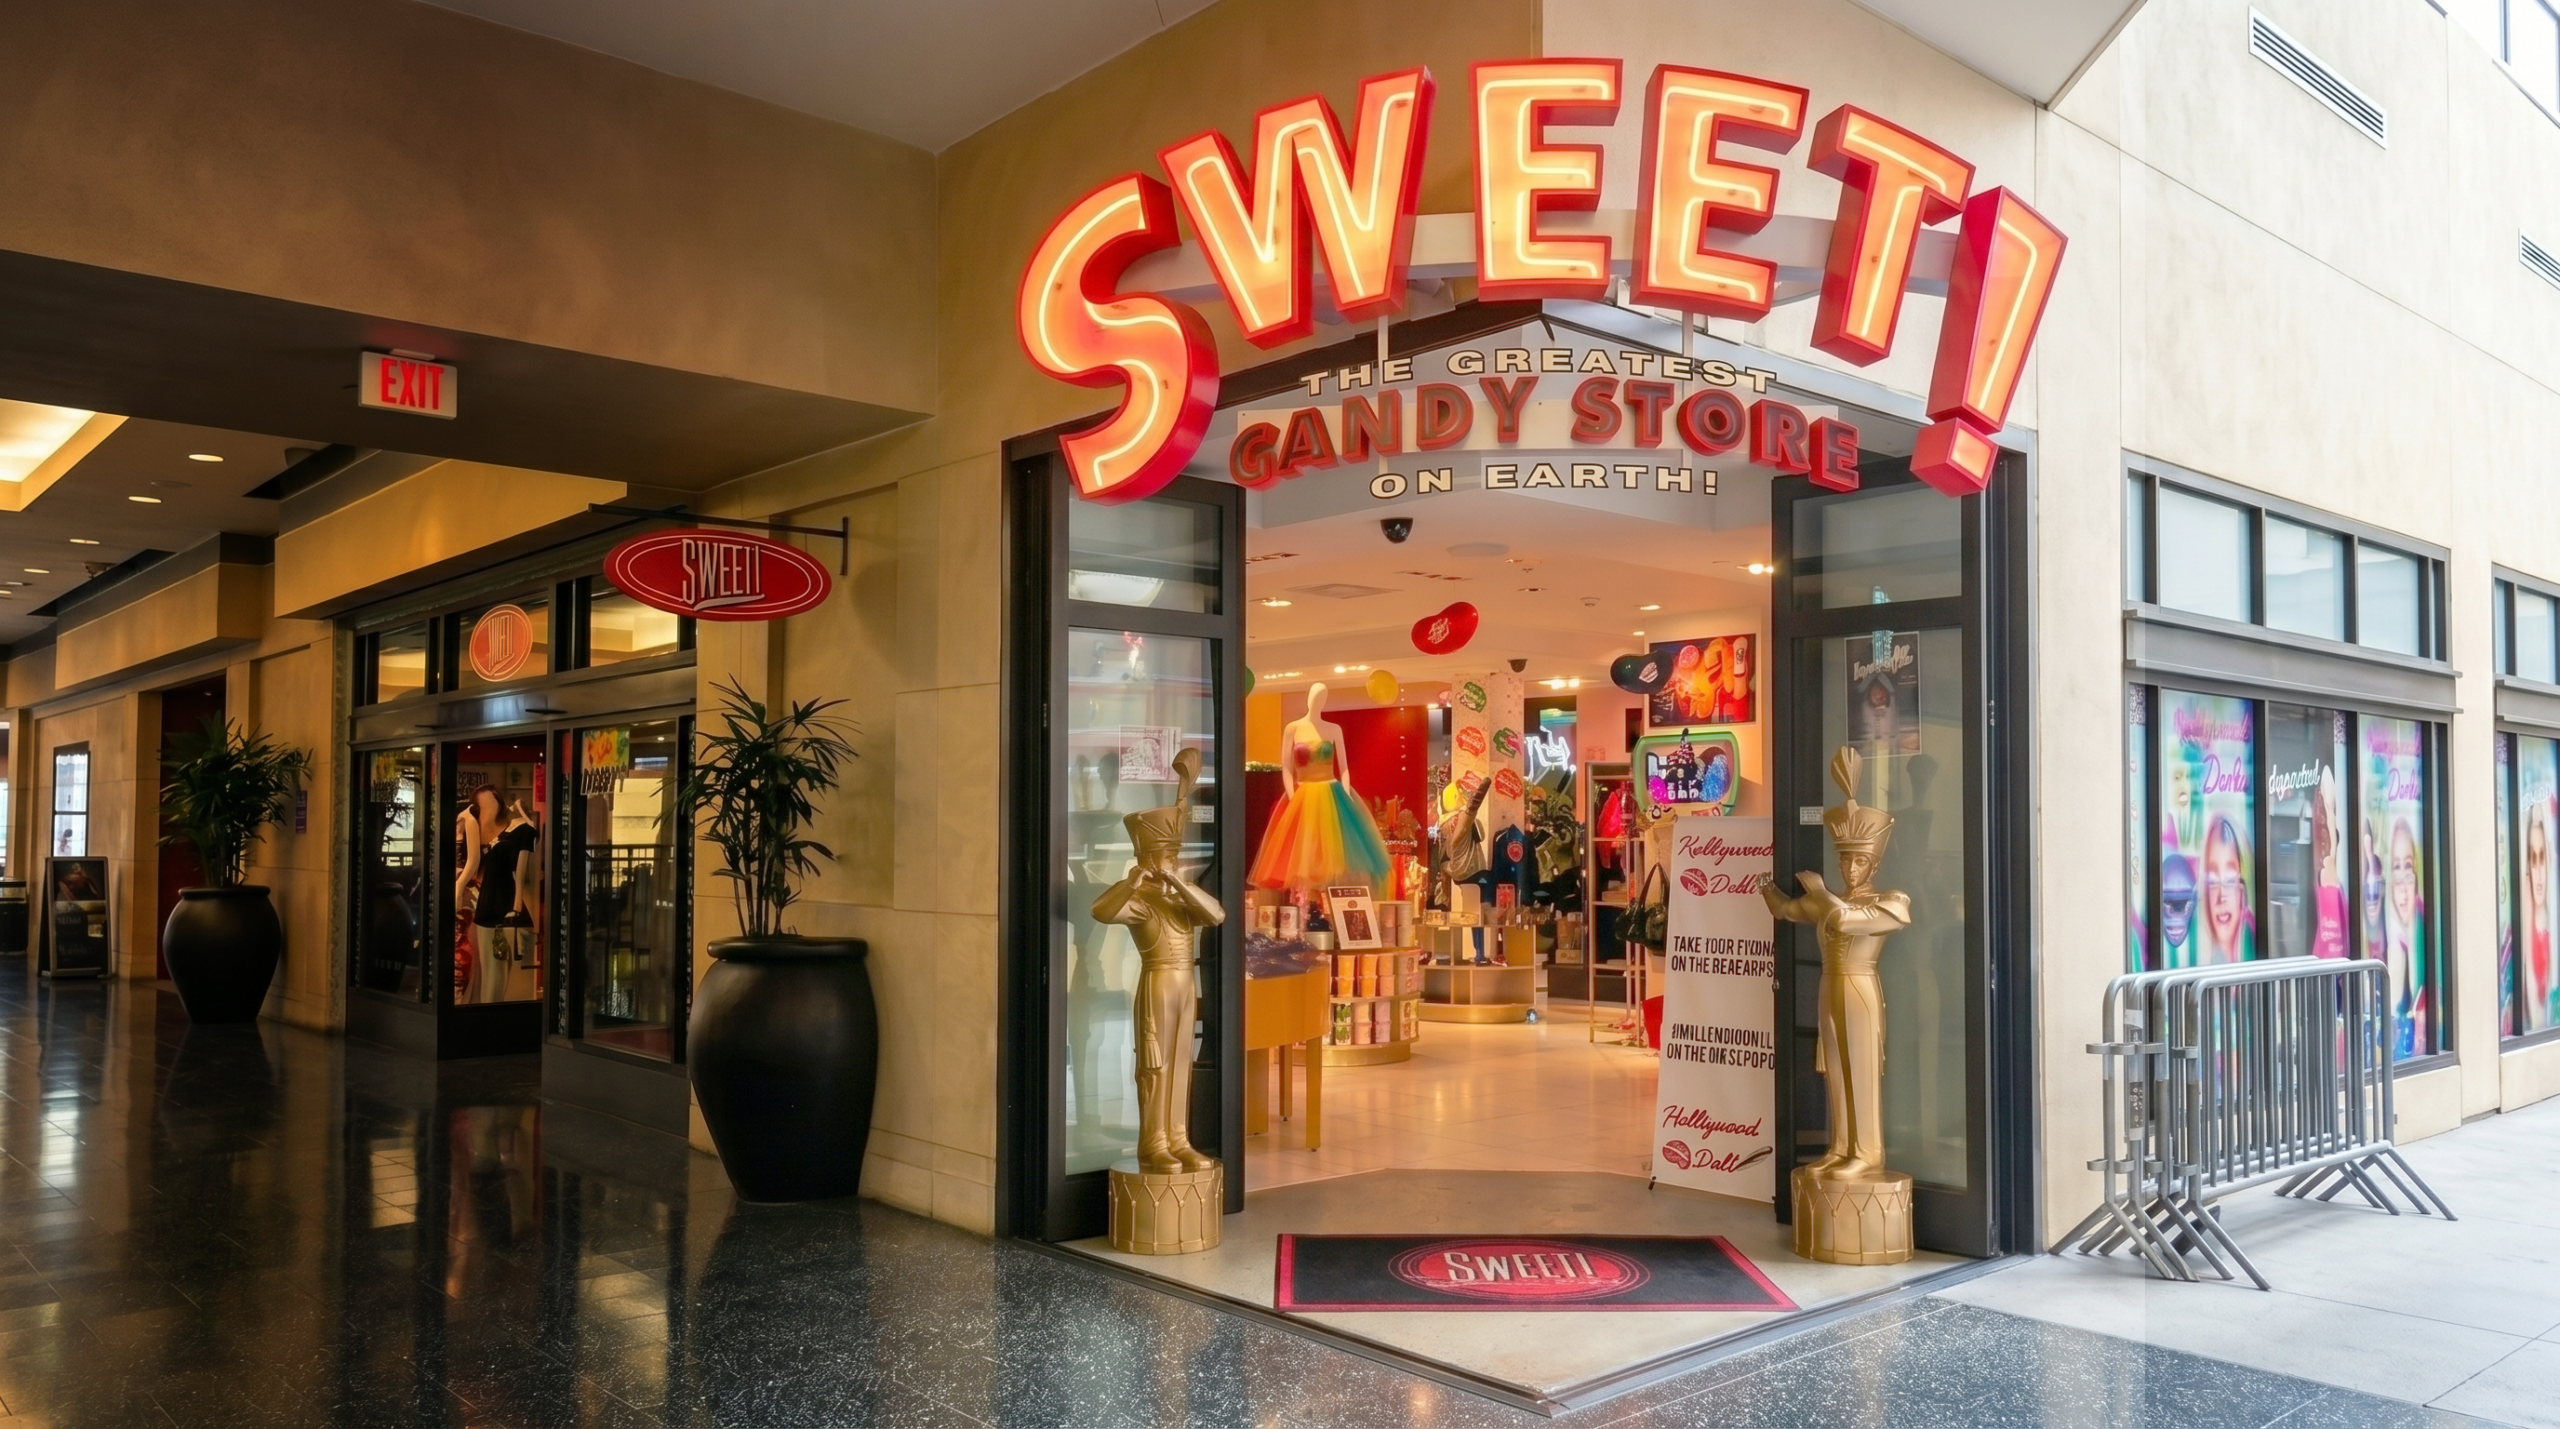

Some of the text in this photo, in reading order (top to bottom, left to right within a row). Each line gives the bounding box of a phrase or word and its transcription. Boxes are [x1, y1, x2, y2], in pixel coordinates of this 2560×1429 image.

[1016, 58, 2069, 506] SWEET!
[381, 357, 444, 410] EXIT
[1300, 347, 1778, 397] THE GREATEST
[1570, 375, 1860, 492] STORE
[1369, 463, 1718, 499] ON EARTH!
[1671, 955, 1687, 972] ON
[1689, 957, 1709, 974] THE
[1674, 936, 1702, 953] TAKE
[1666, 1043, 1682, 1060] ON
[1684, 1044, 1706, 1063] THE
